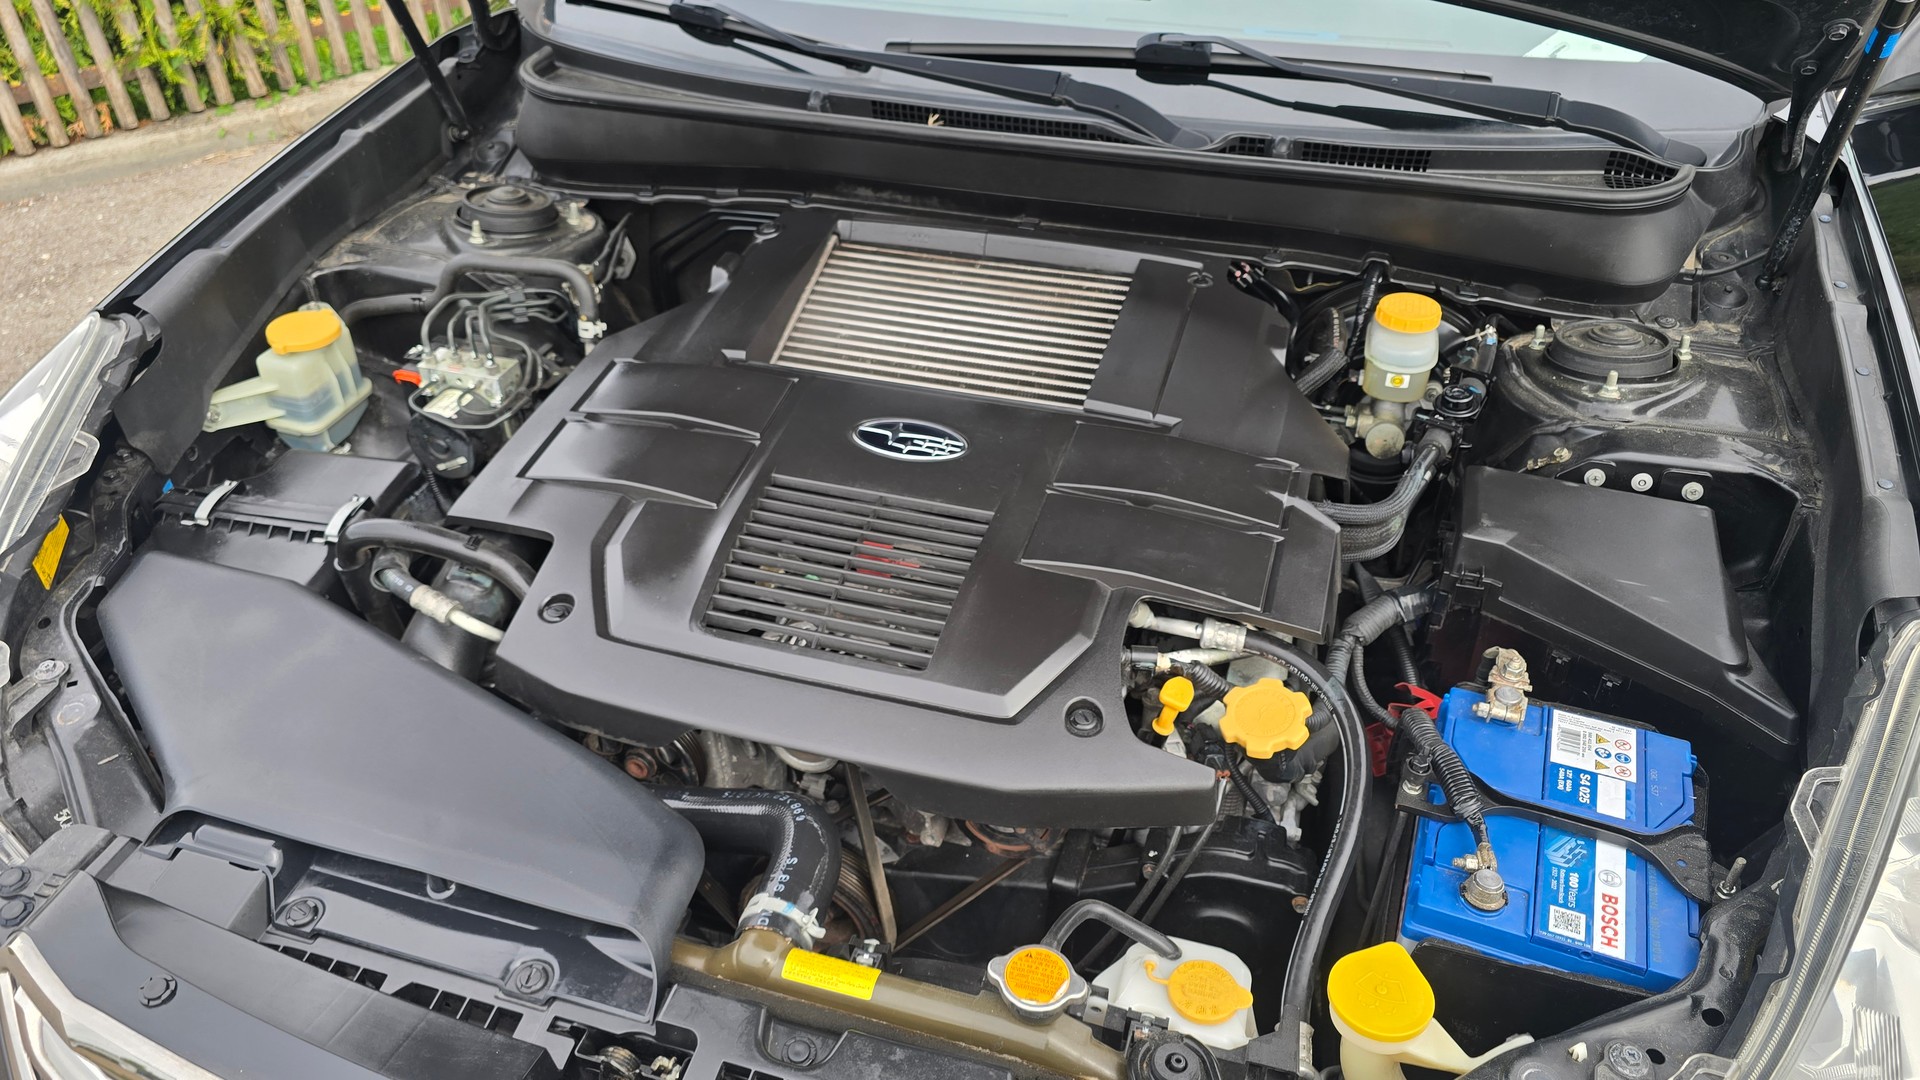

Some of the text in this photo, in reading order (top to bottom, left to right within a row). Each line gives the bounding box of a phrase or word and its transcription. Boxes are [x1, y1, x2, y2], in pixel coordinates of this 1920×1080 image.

[1579, 773, 1591, 804] S4 025
[1600, 892, 1619, 949] BOSCH
